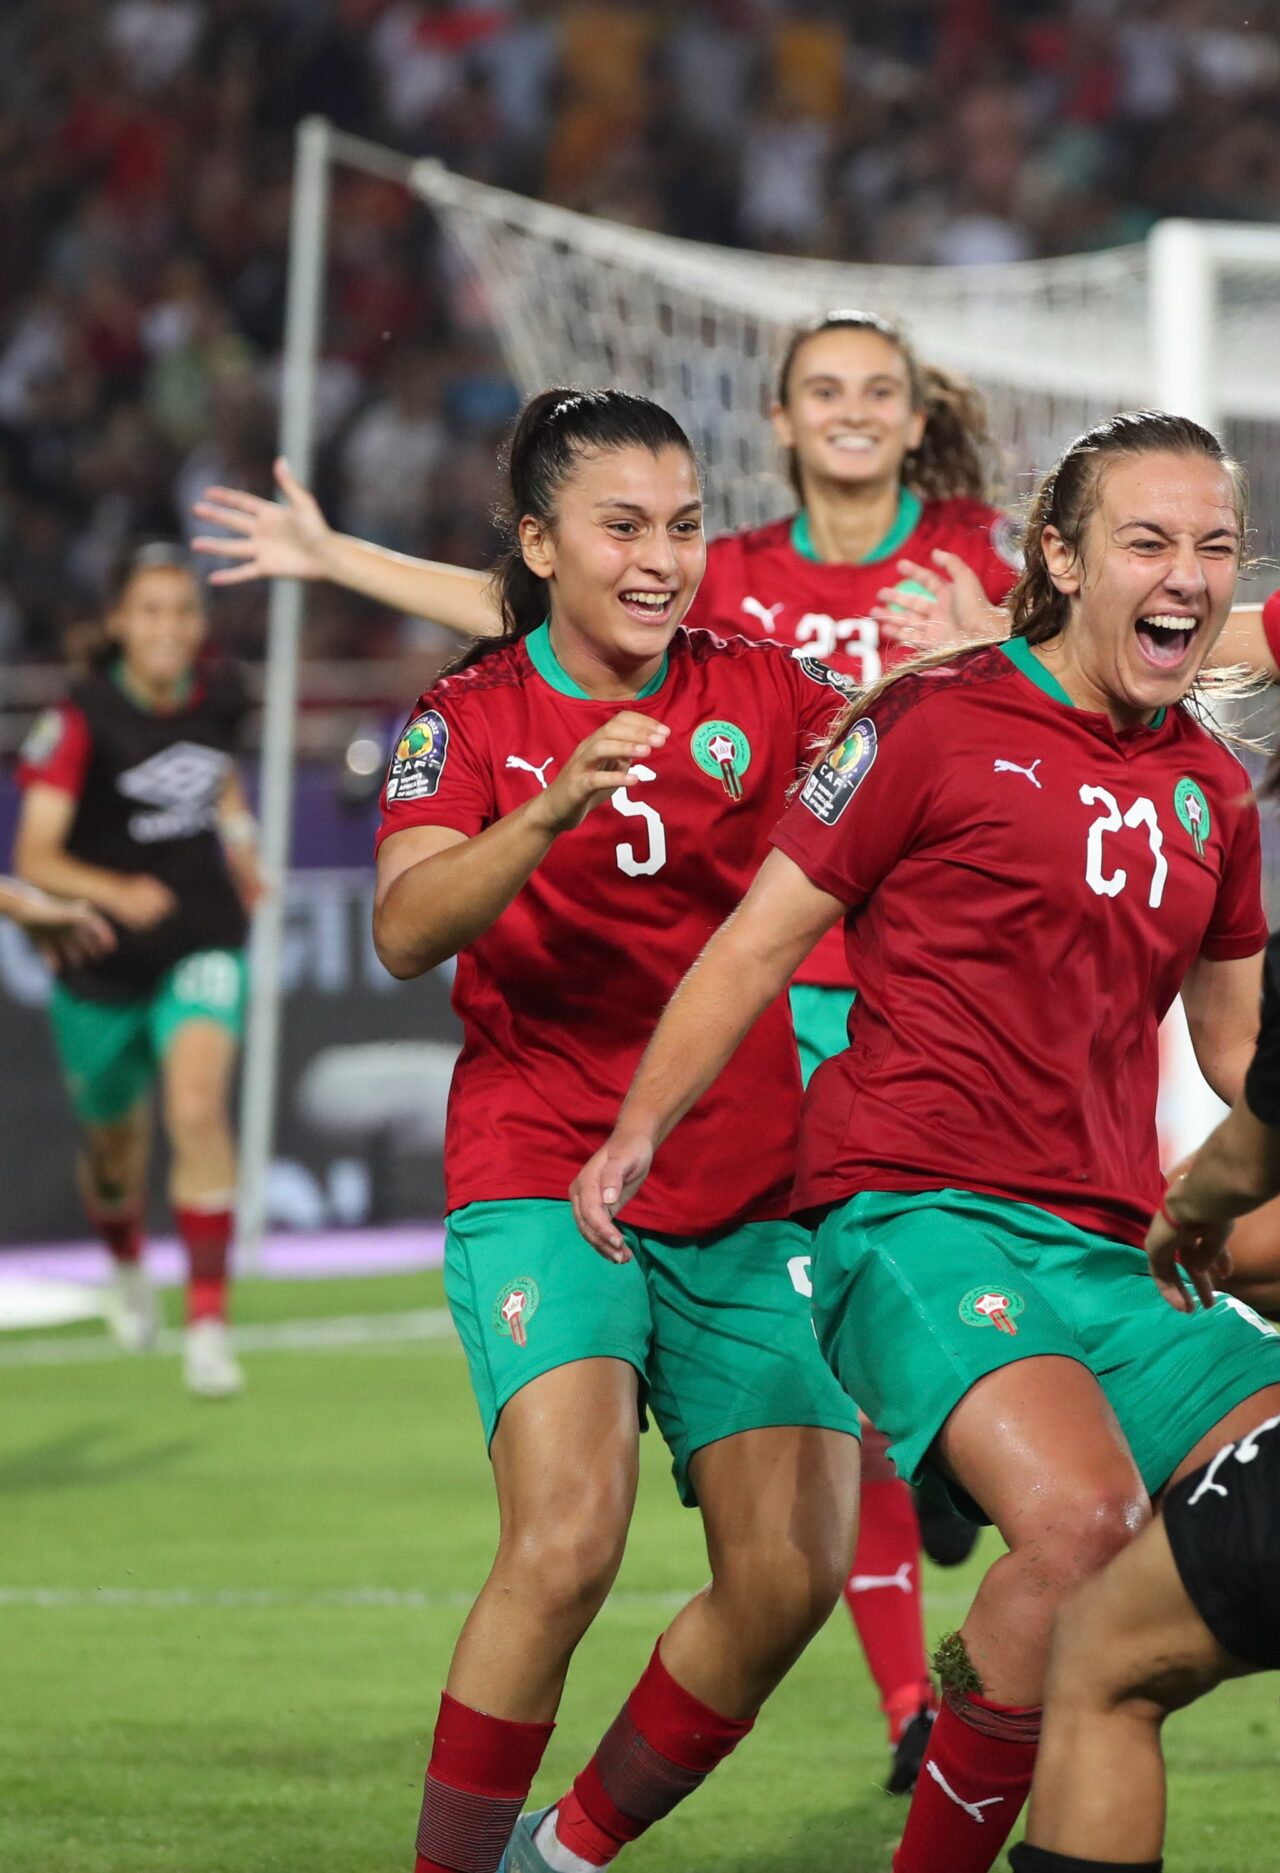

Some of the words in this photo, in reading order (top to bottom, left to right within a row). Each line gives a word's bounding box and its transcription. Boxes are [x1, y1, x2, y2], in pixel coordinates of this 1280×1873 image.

[795, 612, 882, 684] 23
[392, 760, 427, 775] CAF
[820, 764, 843, 788] CAF
[610, 763, 667, 878] 5
